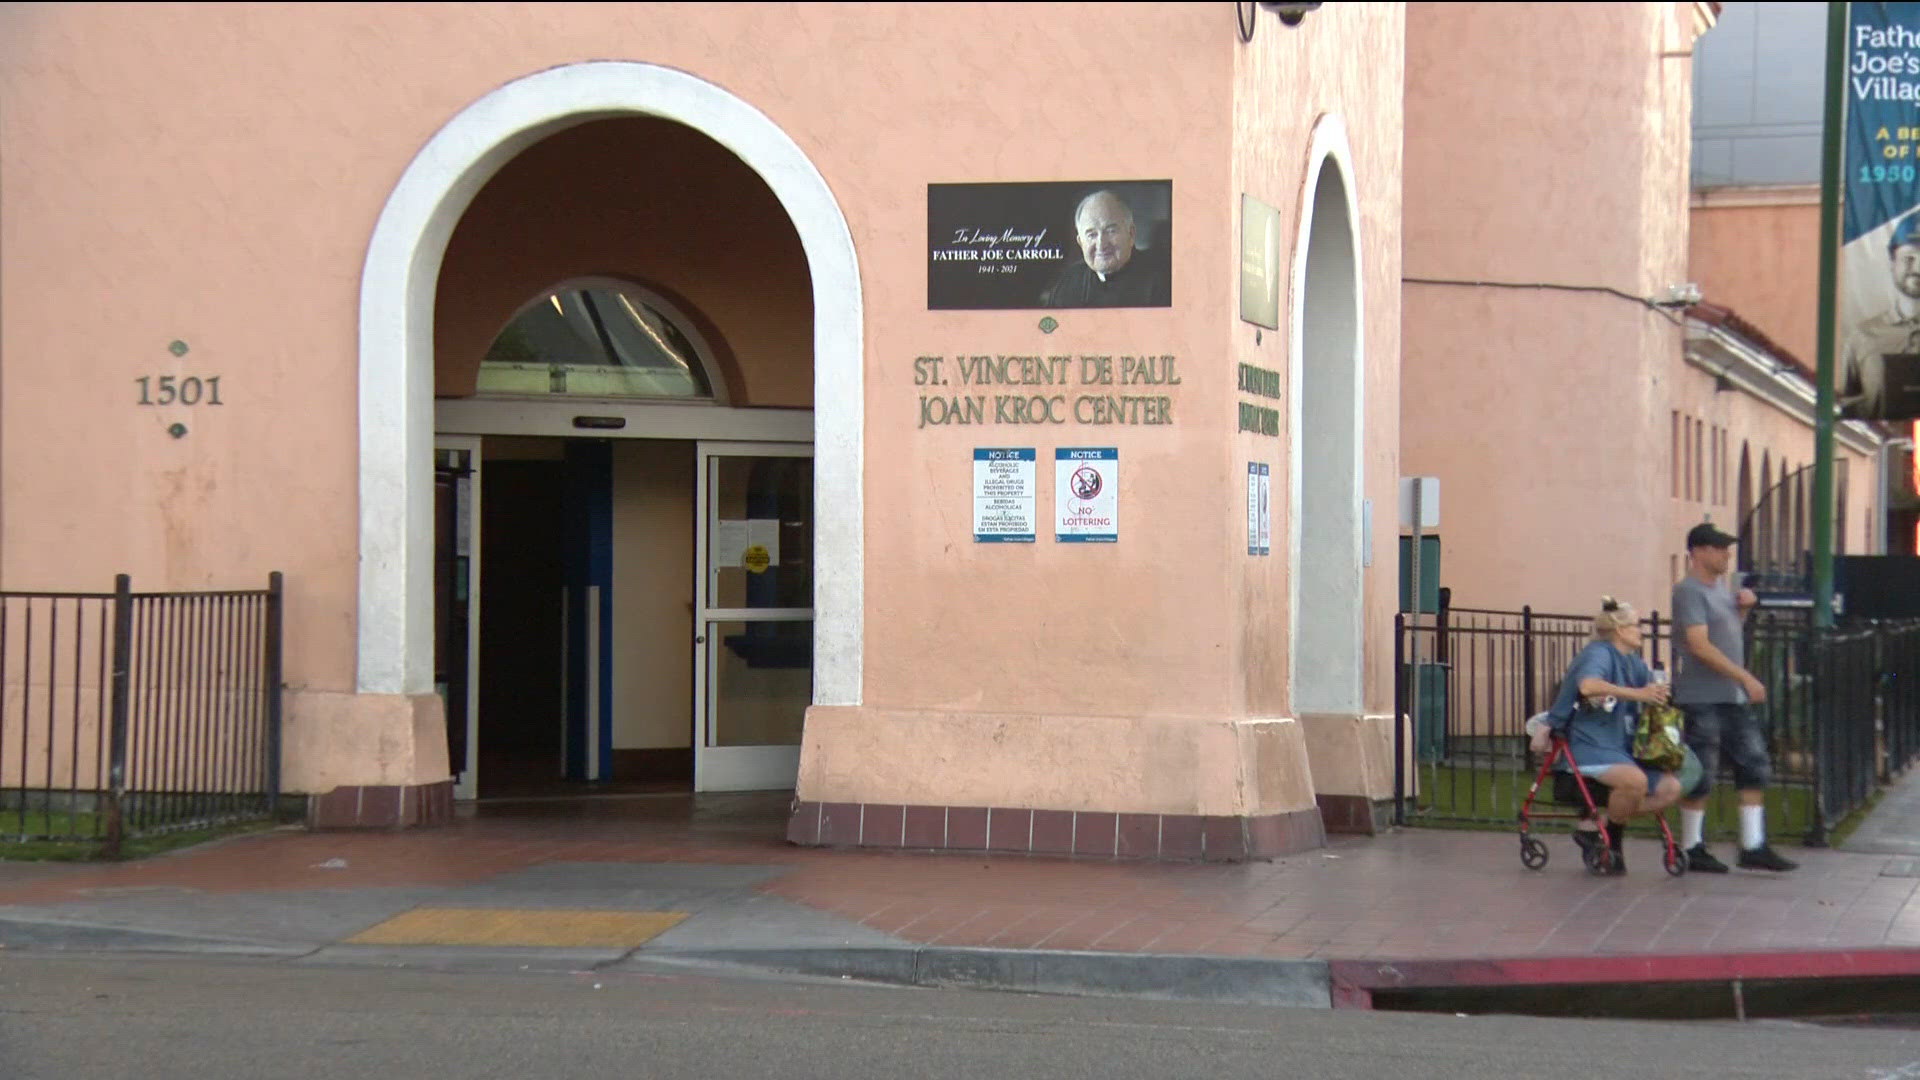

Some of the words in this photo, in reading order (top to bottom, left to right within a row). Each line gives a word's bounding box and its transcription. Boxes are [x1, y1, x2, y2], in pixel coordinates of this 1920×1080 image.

[1851, 51, 1920, 74] Joe's
[1875, 127, 1890, 140] A
[1883, 145, 1910, 159] OF
[1859, 165, 1916, 183] 1950
[952, 228, 969, 244] In
[969, 229, 998, 248] Loving
[998, 228, 1033, 248] Memory
[1033, 228, 1047, 248] of
[933, 250, 979, 261] FATHER
[981, 250, 1004, 261] JOE
[1006, 249, 1064, 260] CARROLL
[978, 265, 995, 273] 1941
[1001, 265, 1017, 273] 2021
[913, 356, 948, 386] ST.
[957, 355, 1072, 386] VINCENT
[1080, 356, 1113, 386] DE
[1120, 356, 1182, 386] PAUL
[135, 375, 224, 406] 1501
[918, 395, 986, 429] JOAN
[994, 395, 1066, 425] KROC
[1074, 395, 1173, 425] CENTER
[989, 451, 1020, 459] NOTICE
[1070, 451, 1102, 459] NOTICE
[1078, 507, 1093, 515] NO
[1062, 517, 1110, 526] LOITERING
